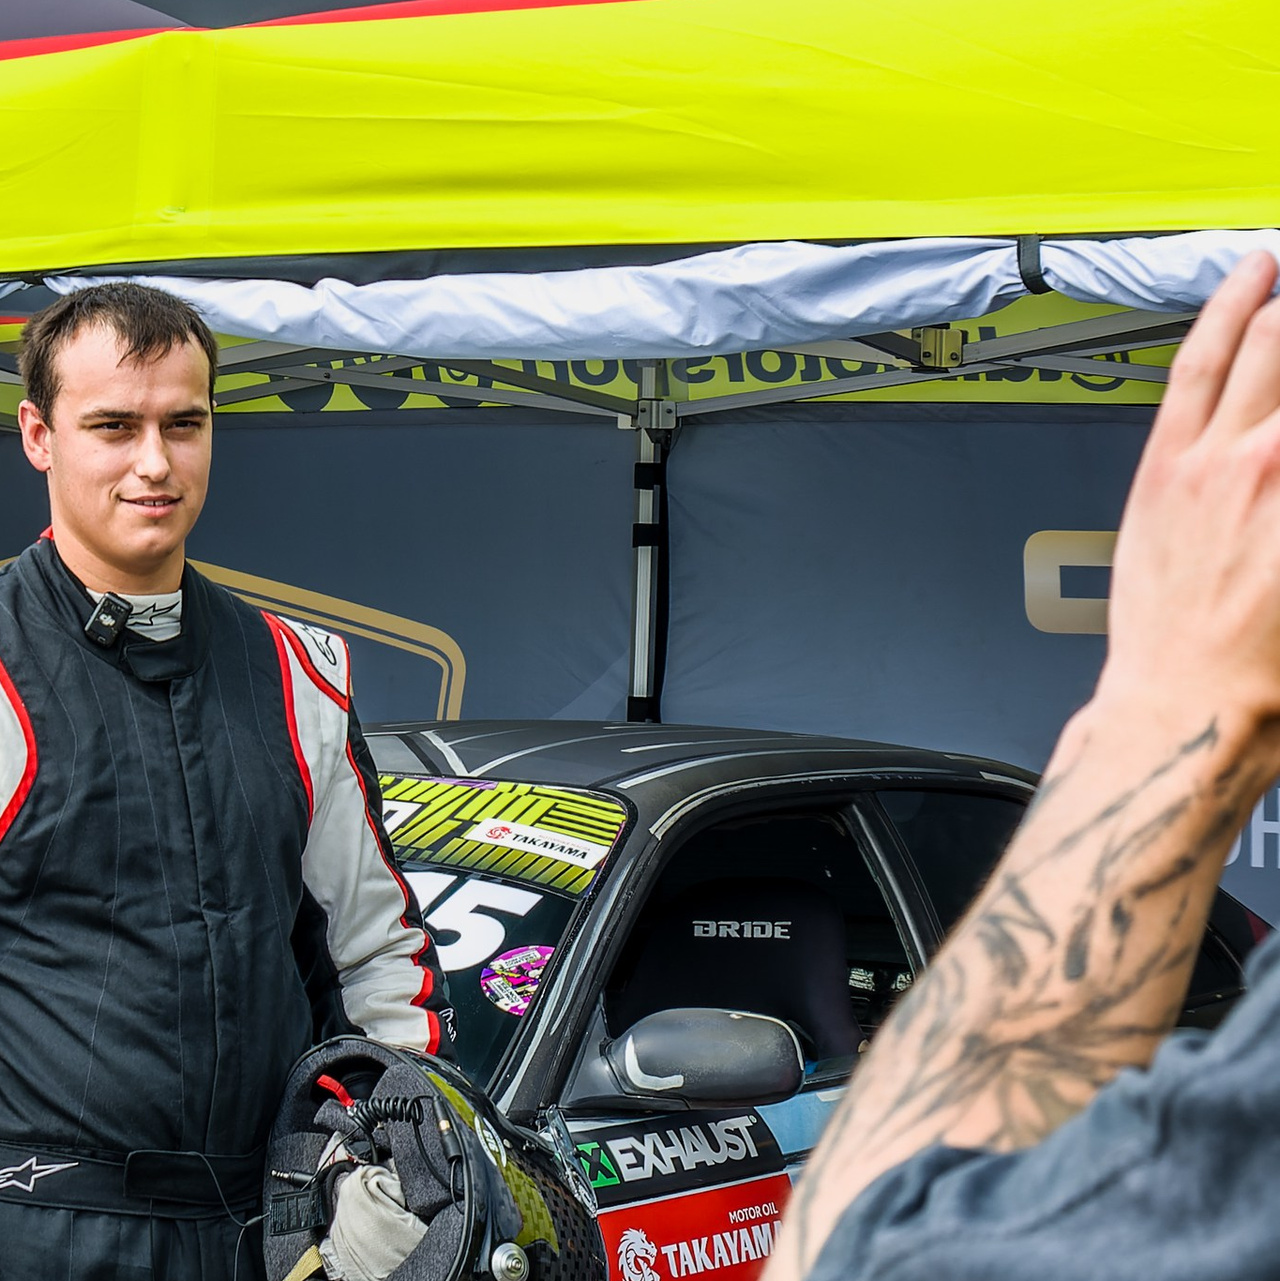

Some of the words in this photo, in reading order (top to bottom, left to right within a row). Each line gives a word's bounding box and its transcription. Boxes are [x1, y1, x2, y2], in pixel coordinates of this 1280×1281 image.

[511, 833, 588, 860] TAKAYAMA
[692, 920, 792, 939] BRIDE
[606, 1116, 758, 1182] EXHAUST
[728, 1206, 761, 1224] MOTOR
[762, 1201, 778, 1217] OIL
